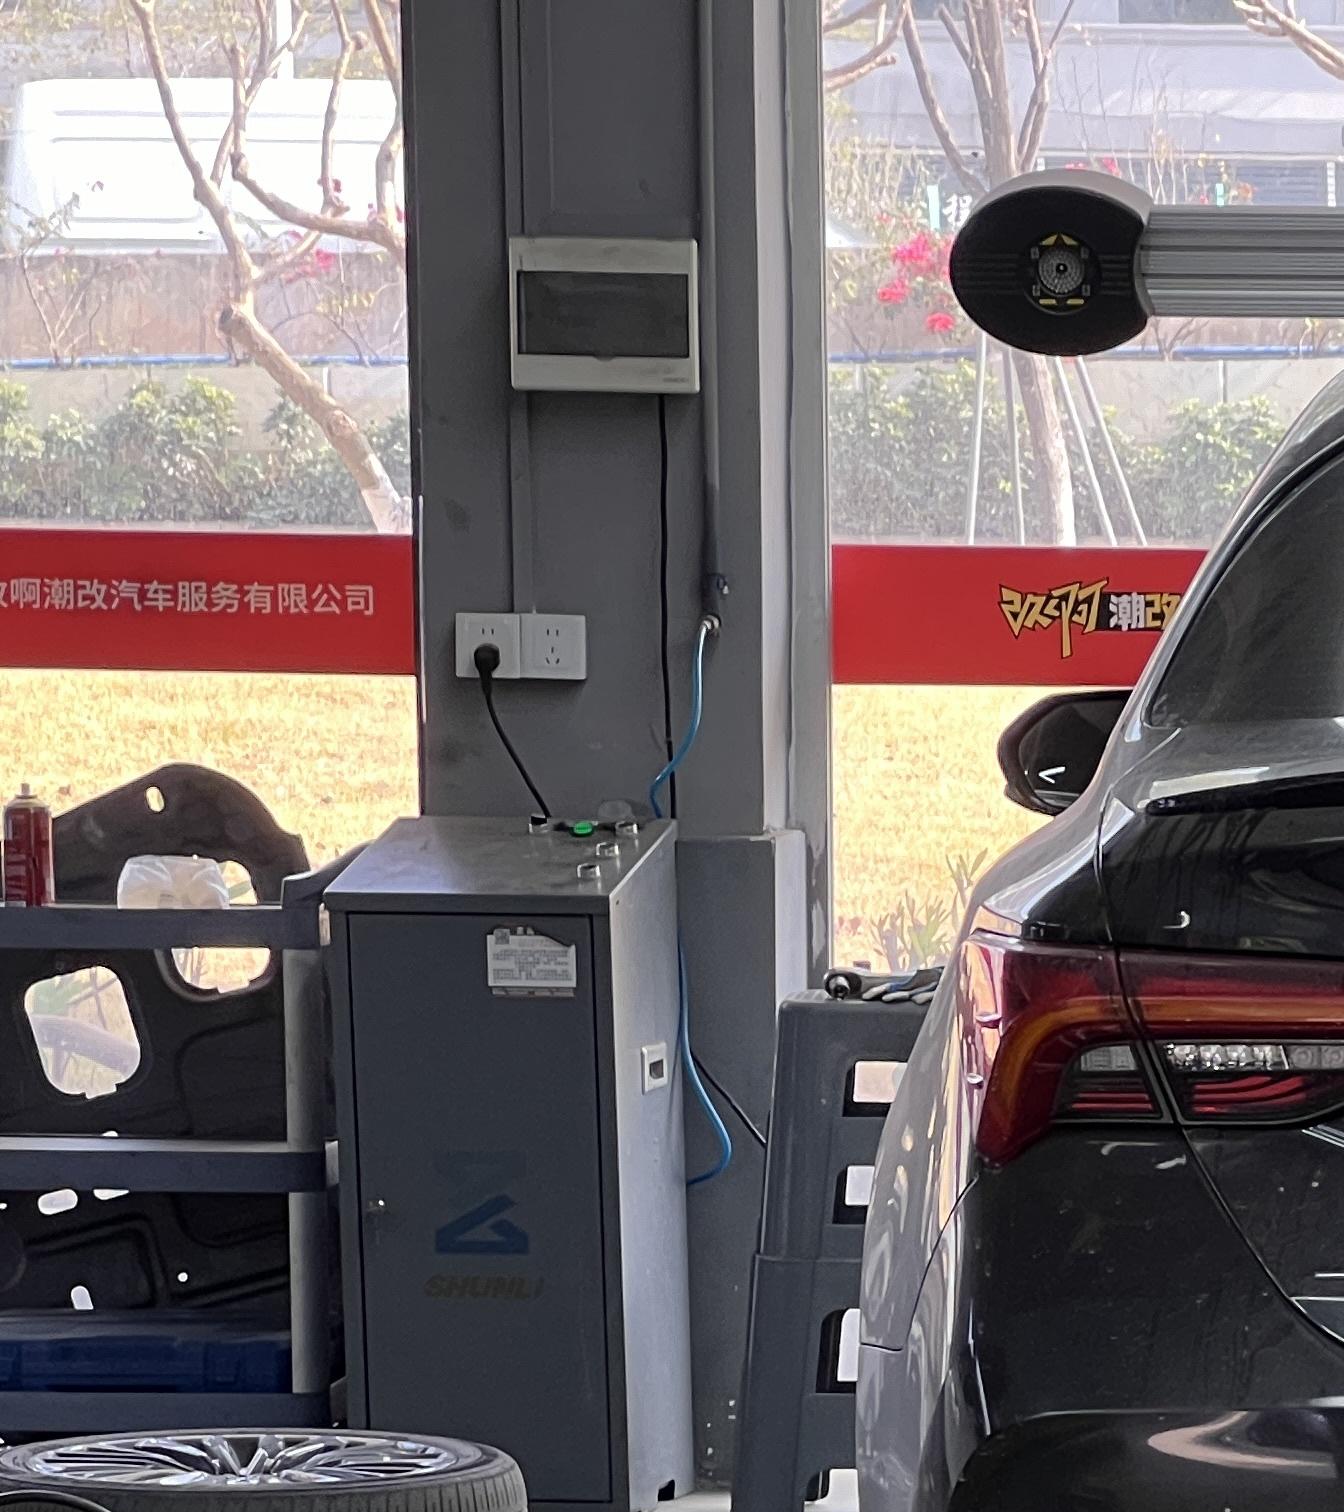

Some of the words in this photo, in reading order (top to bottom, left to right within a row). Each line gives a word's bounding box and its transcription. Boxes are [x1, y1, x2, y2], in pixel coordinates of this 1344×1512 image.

[0, 577, 375, 616] 啊潮改汽车服务有限公司
